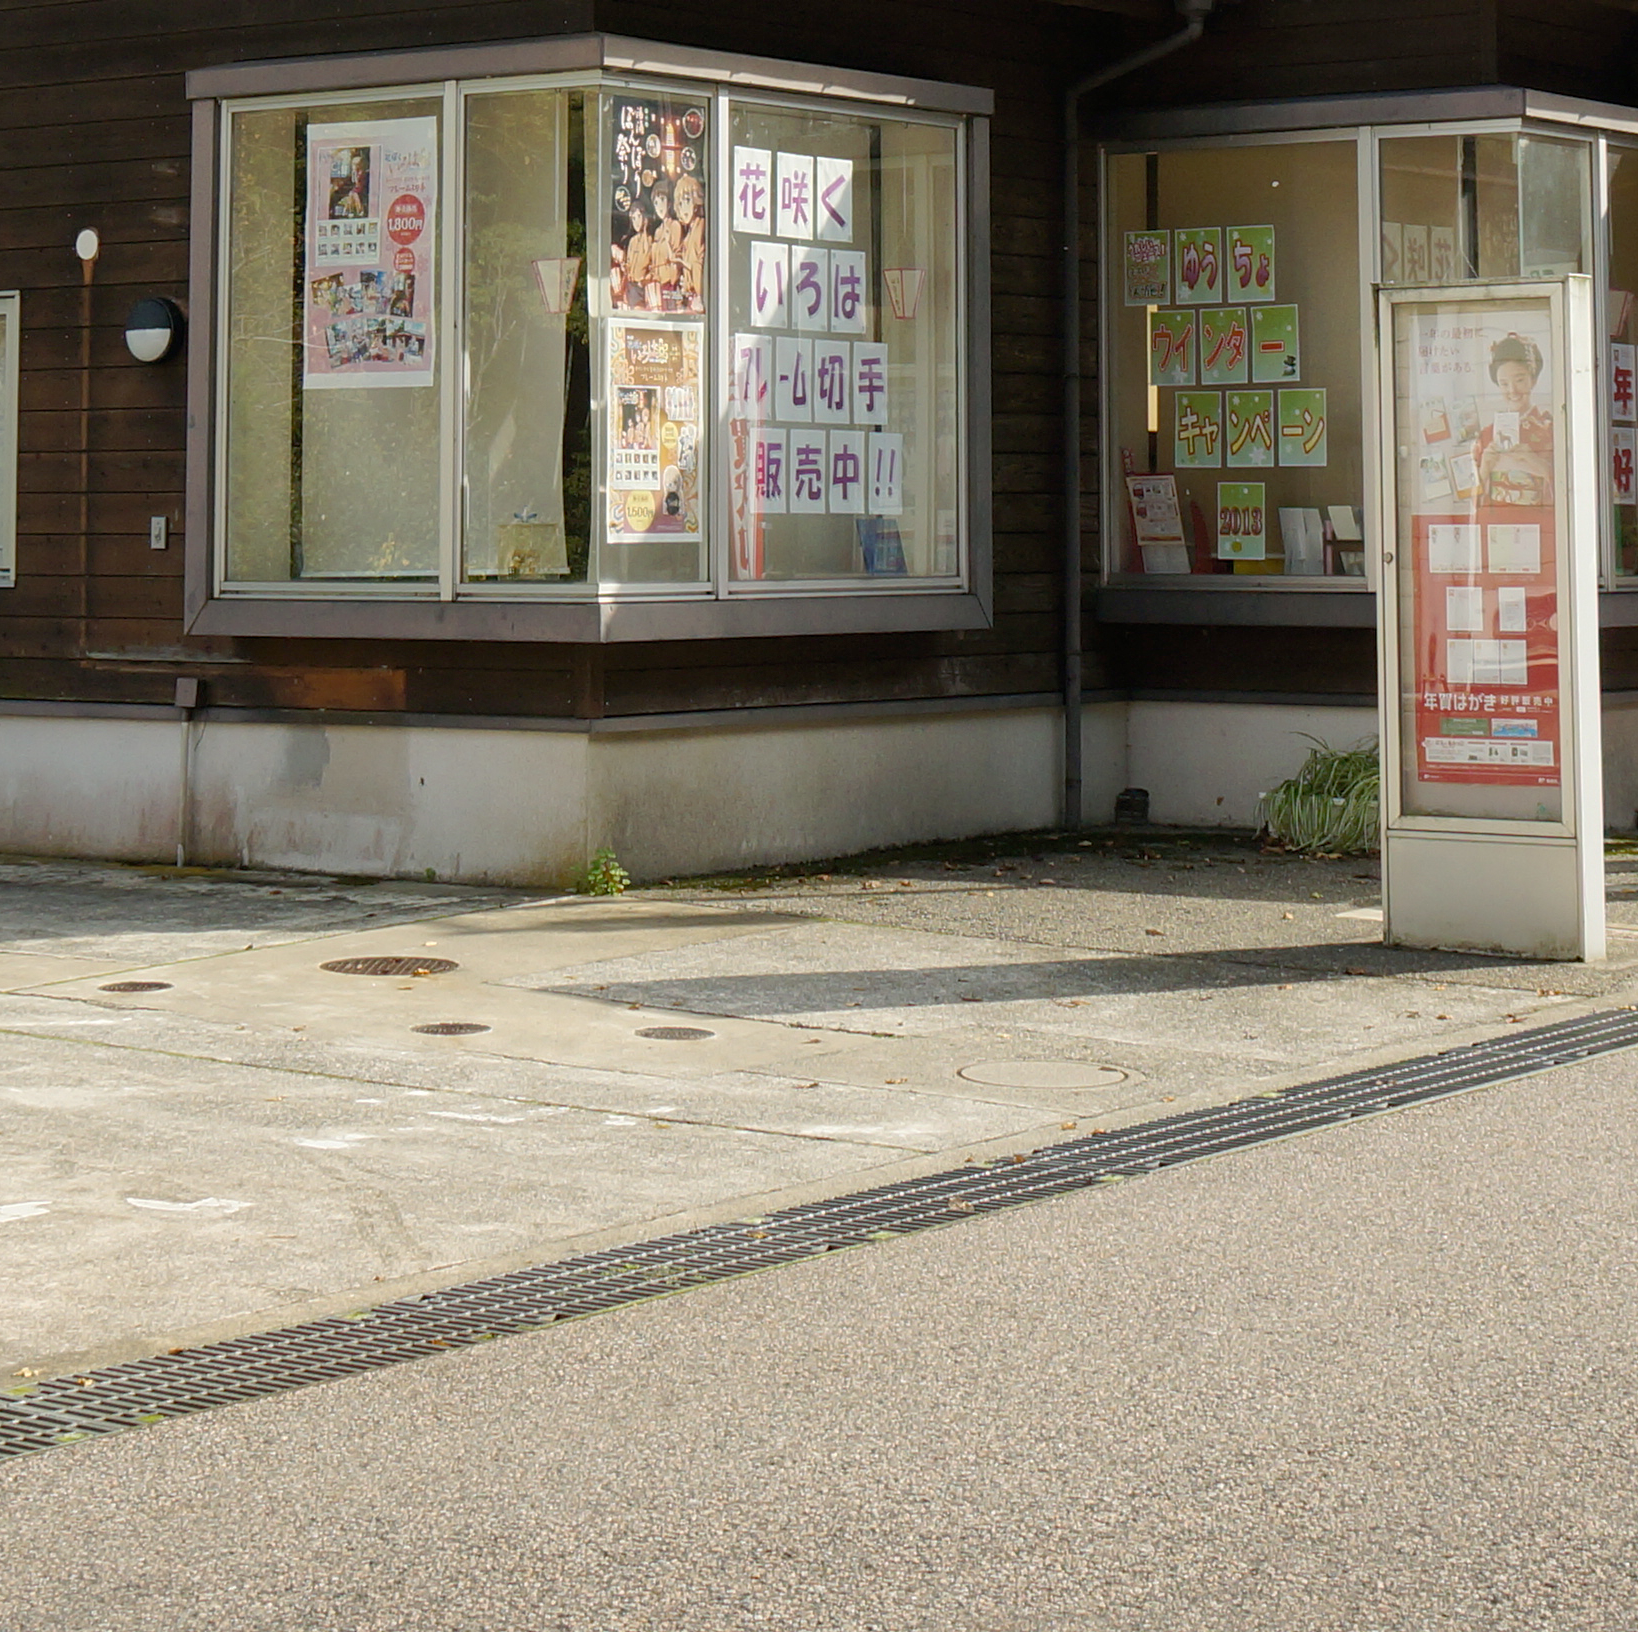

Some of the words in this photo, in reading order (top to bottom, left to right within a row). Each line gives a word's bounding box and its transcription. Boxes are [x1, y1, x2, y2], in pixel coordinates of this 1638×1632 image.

[739, 162, 847, 228] 花咲く
[757, 256, 862, 322] いろは
[1181, 240, 1271, 290] ゆうちょ
[1152, 322, 1285, 371] ウインター
[1178, 405, 1325, 456] キャンペーン
[1219, 506, 1263, 536] 2013
[1424, 692, 1497, 713] 年賀はがき
